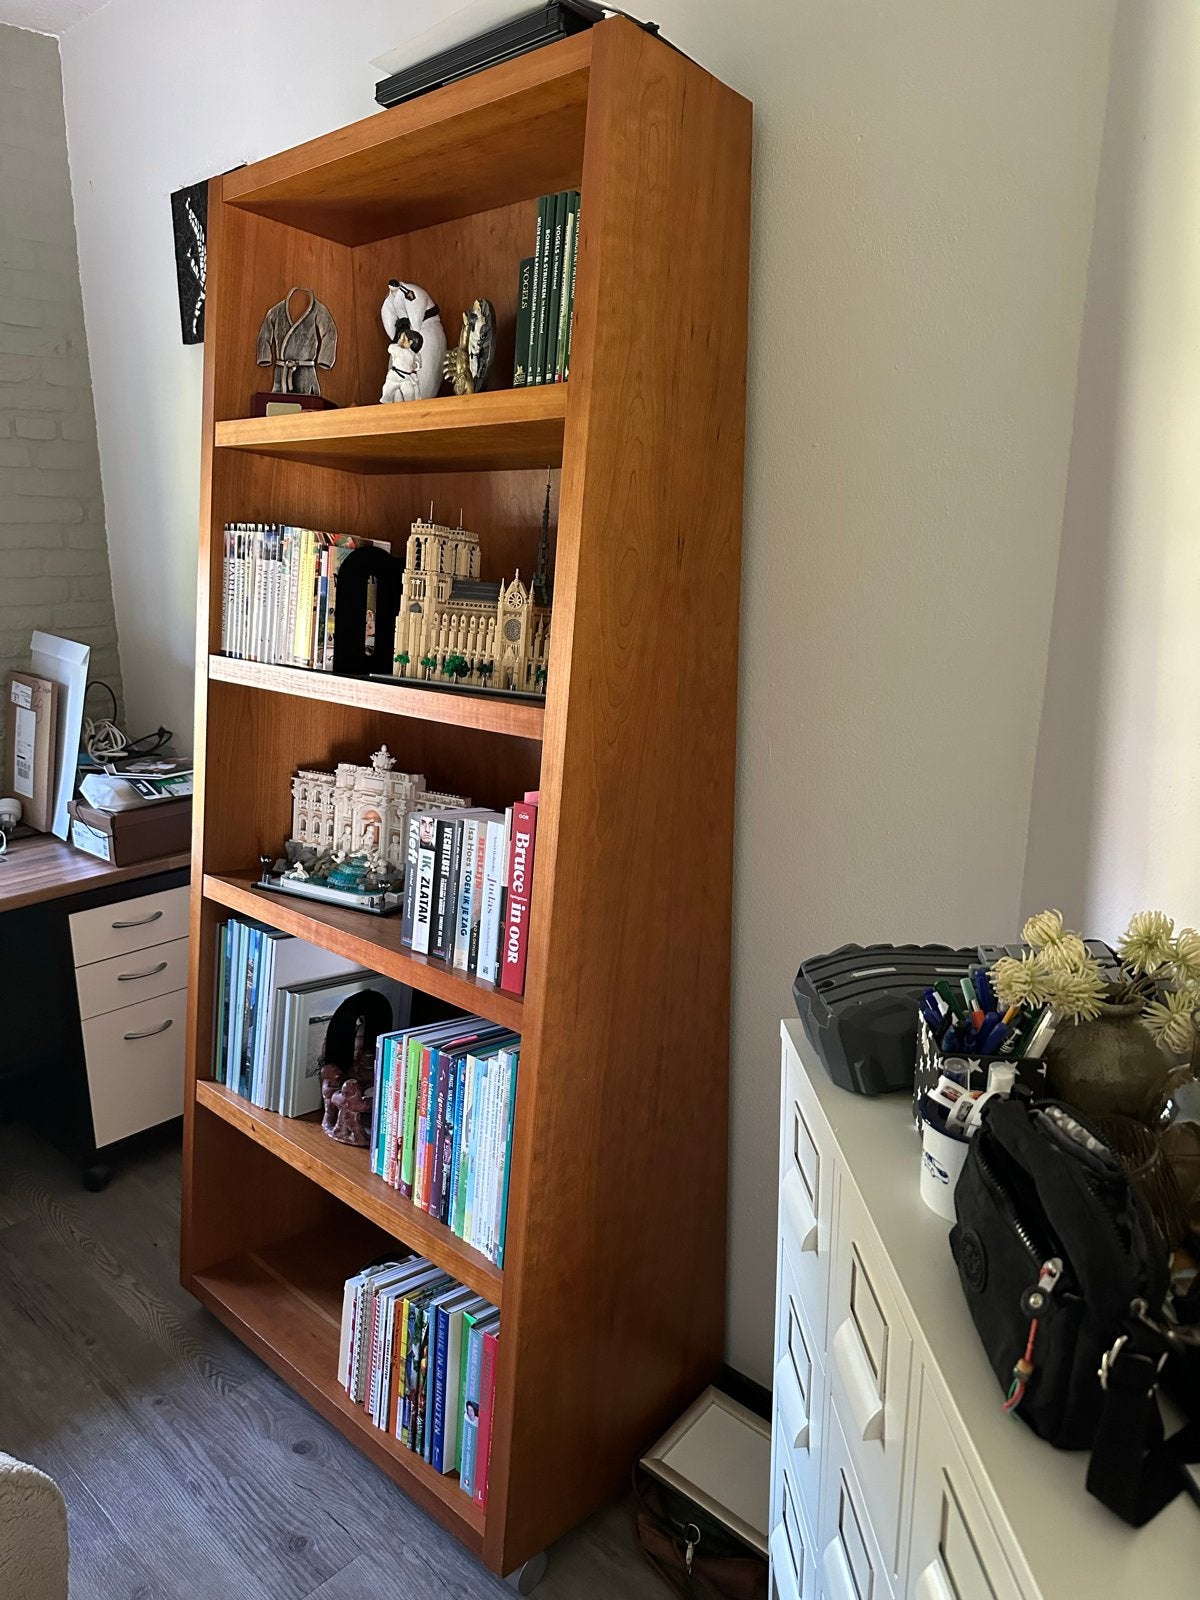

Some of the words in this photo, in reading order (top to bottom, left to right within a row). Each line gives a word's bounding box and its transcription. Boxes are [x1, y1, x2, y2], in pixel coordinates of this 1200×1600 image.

[522, 266, 530, 309] VOGELS
[408, 818, 420, 864] Kieft
[442, 827, 453, 877] VECHTLUST
[466, 844, 474, 872] Hoes
[420, 854, 431, 872] IK,
[475, 836, 485, 890] BERLIJN
[512, 832, 530, 893] Bruce
[418, 876, 431, 924] ZLATAN
[462, 905, 469, 915] JE
[463, 895, 470, 905] IK
[487, 873, 497, 914] Judas
[510, 902, 526, 924] in
[460, 916, 468, 936] ZAG
[507, 926, 522, 964] OOR
[419, 1076, 428, 1117] dyslexie
[438, 1311, 448, 1351] JAMIE
[437, 1366, 444, 1379] 30
[438, 1351, 445, 1365] IN
[434, 1379, 444, 1436] MINUTEN
